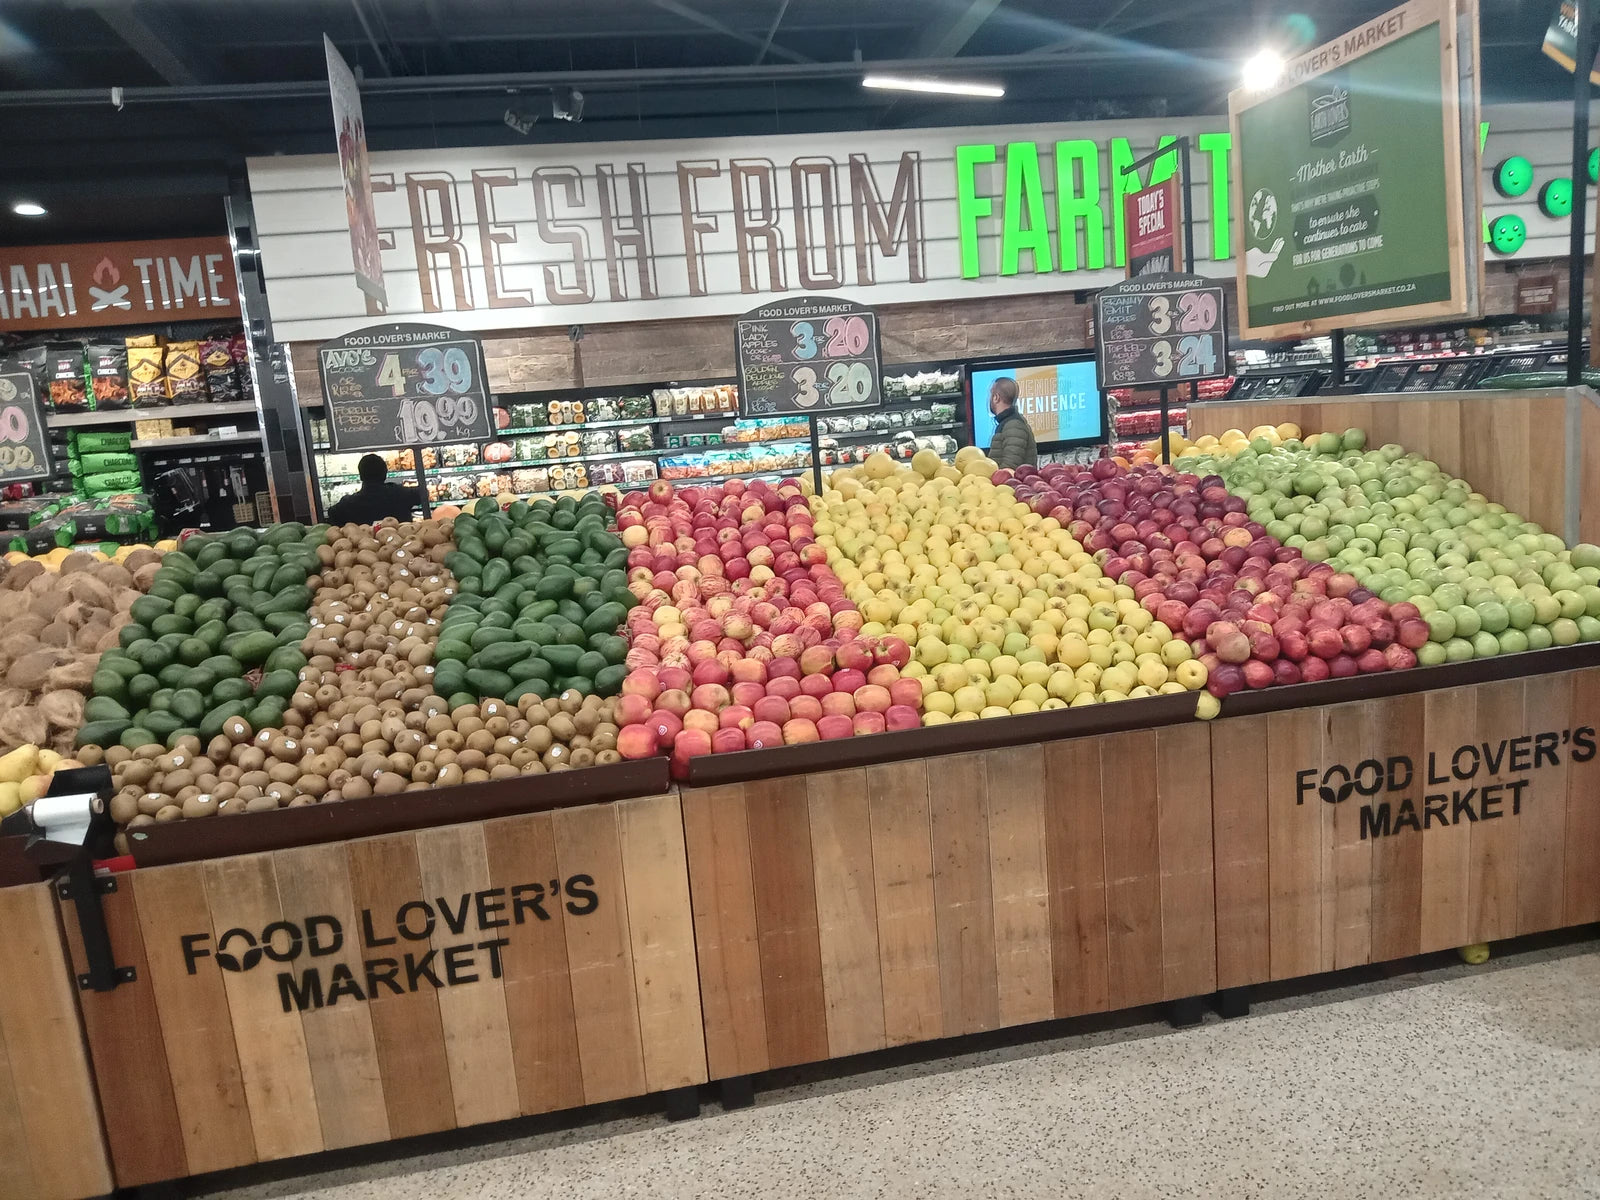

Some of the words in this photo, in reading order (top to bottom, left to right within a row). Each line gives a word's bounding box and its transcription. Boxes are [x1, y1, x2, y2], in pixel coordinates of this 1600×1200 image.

[1344, 11, 1407, 57] MARKET
[1297, 158, 1337, 182] Mother
[1339, 143, 1368, 169] Earth
[1137, 188, 1165, 216] TODAY'S
[676, 150, 928, 297] FROM
[1138, 209, 1166, 237] SPECIAL
[1303, 226, 1340, 245] continues
[1367, 235, 1384, 250] COME
[0, 262, 78, 320] AAI
[132, 254, 231, 312] TIME
[1119, 284, 1141, 293] FOOD
[1142, 281, 1172, 291] LOVER'S
[1173, 279, 1204, 287] MARKET
[759, 308, 782, 317] FOOD
[784, 305, 818, 316] LOVER'S
[819, 303, 853, 313] MARKET
[1148, 296, 1172, 336] 3
[1272, 304, 1285, 312] FIND
[1285, 303, 1295, 311] OUT
[1296, 300, 1310, 310] MORE
[1310, 299, 1318, 307] AT
[344, 336, 370, 346] FOOD
[373, 333, 412, 344] LOVER'S
[413, 331, 451, 341] MARKET
[742, 333, 768, 341] LADY
[742, 340, 778, 349] APPLES
[790, 320, 818, 360] 3
[376, 352, 407, 397] 4
[1151, 340, 1173, 377] 3
[744, 365, 778, 374] GOLDEN
[790, 365, 820, 409] 3
[1015, 391, 1086, 415] VENIENCE
[1295, 754, 1414, 806] FOOD
[1427, 725, 1597, 786] LOVER'S
[1359, 779, 1530, 840] MARKET
[180, 915, 344, 976] FOOD
[362, 873, 600, 949] LOVER'S
[277, 938, 510, 1013] MARKET
